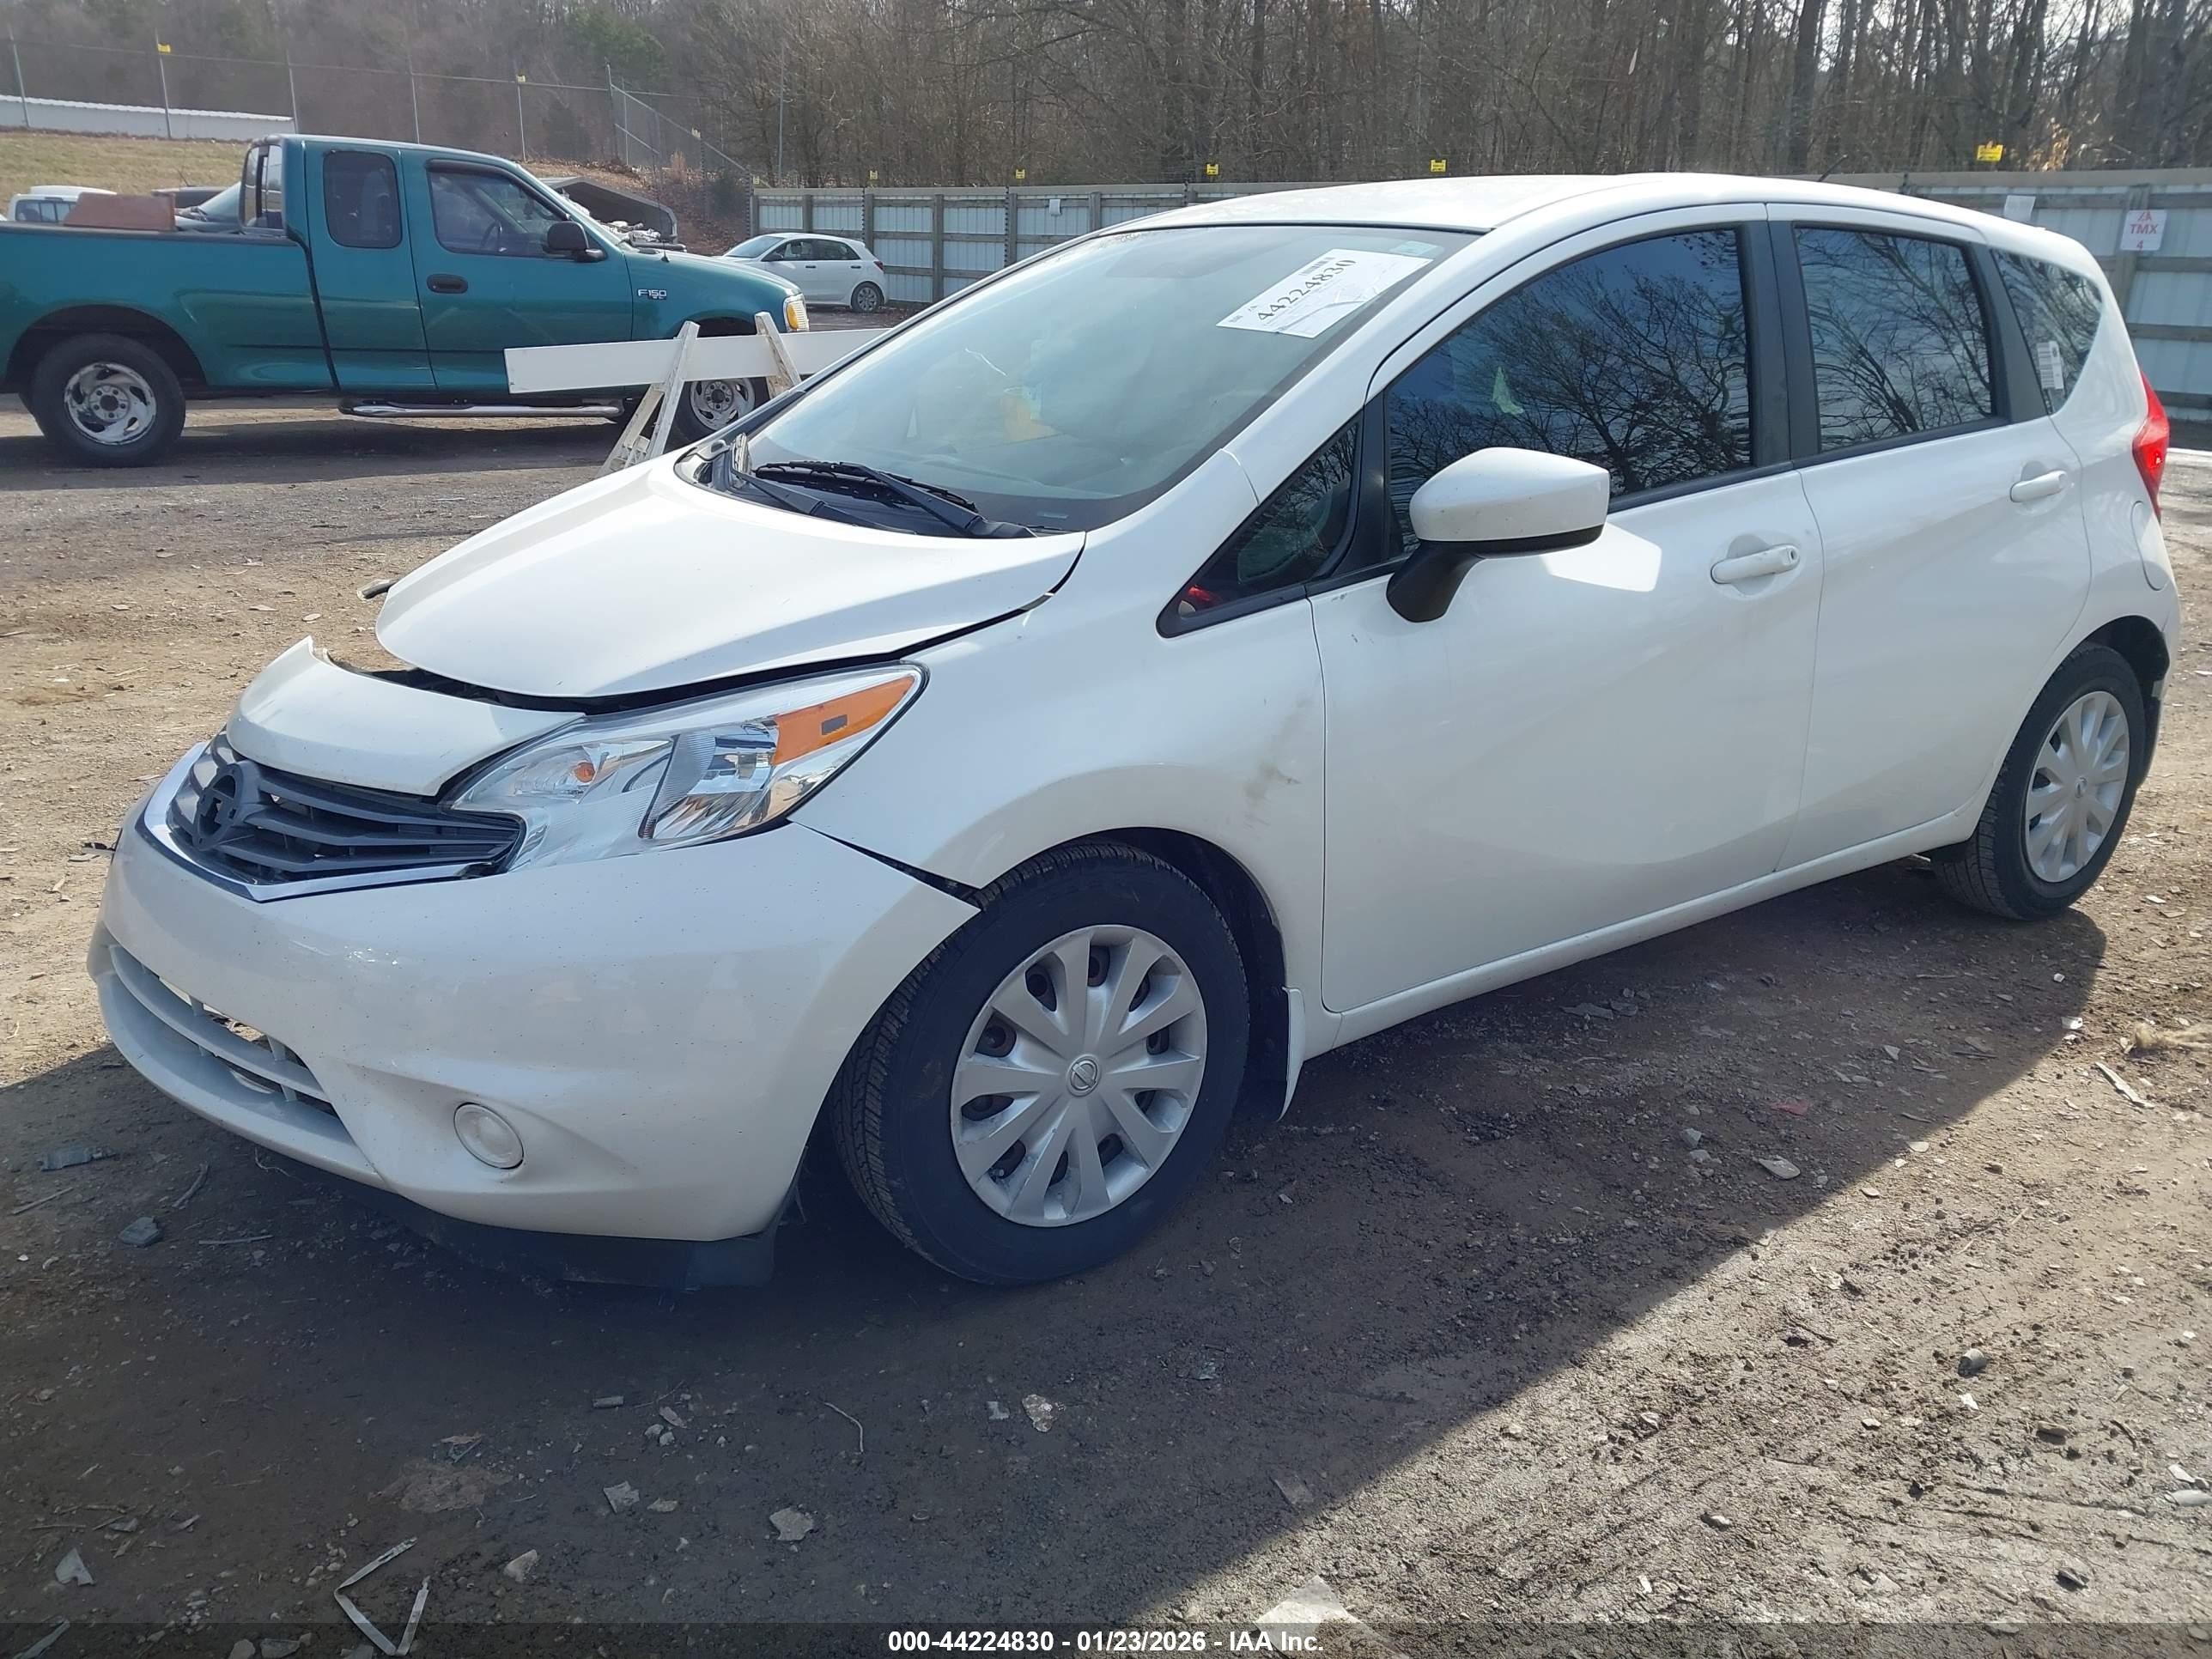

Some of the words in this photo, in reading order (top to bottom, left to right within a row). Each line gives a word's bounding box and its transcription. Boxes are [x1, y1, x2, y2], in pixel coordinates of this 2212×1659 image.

[2130, 223, 2158, 234] TMX
[637, 289, 667, 297] F150
[1257, 259, 1356, 320] 44224830
